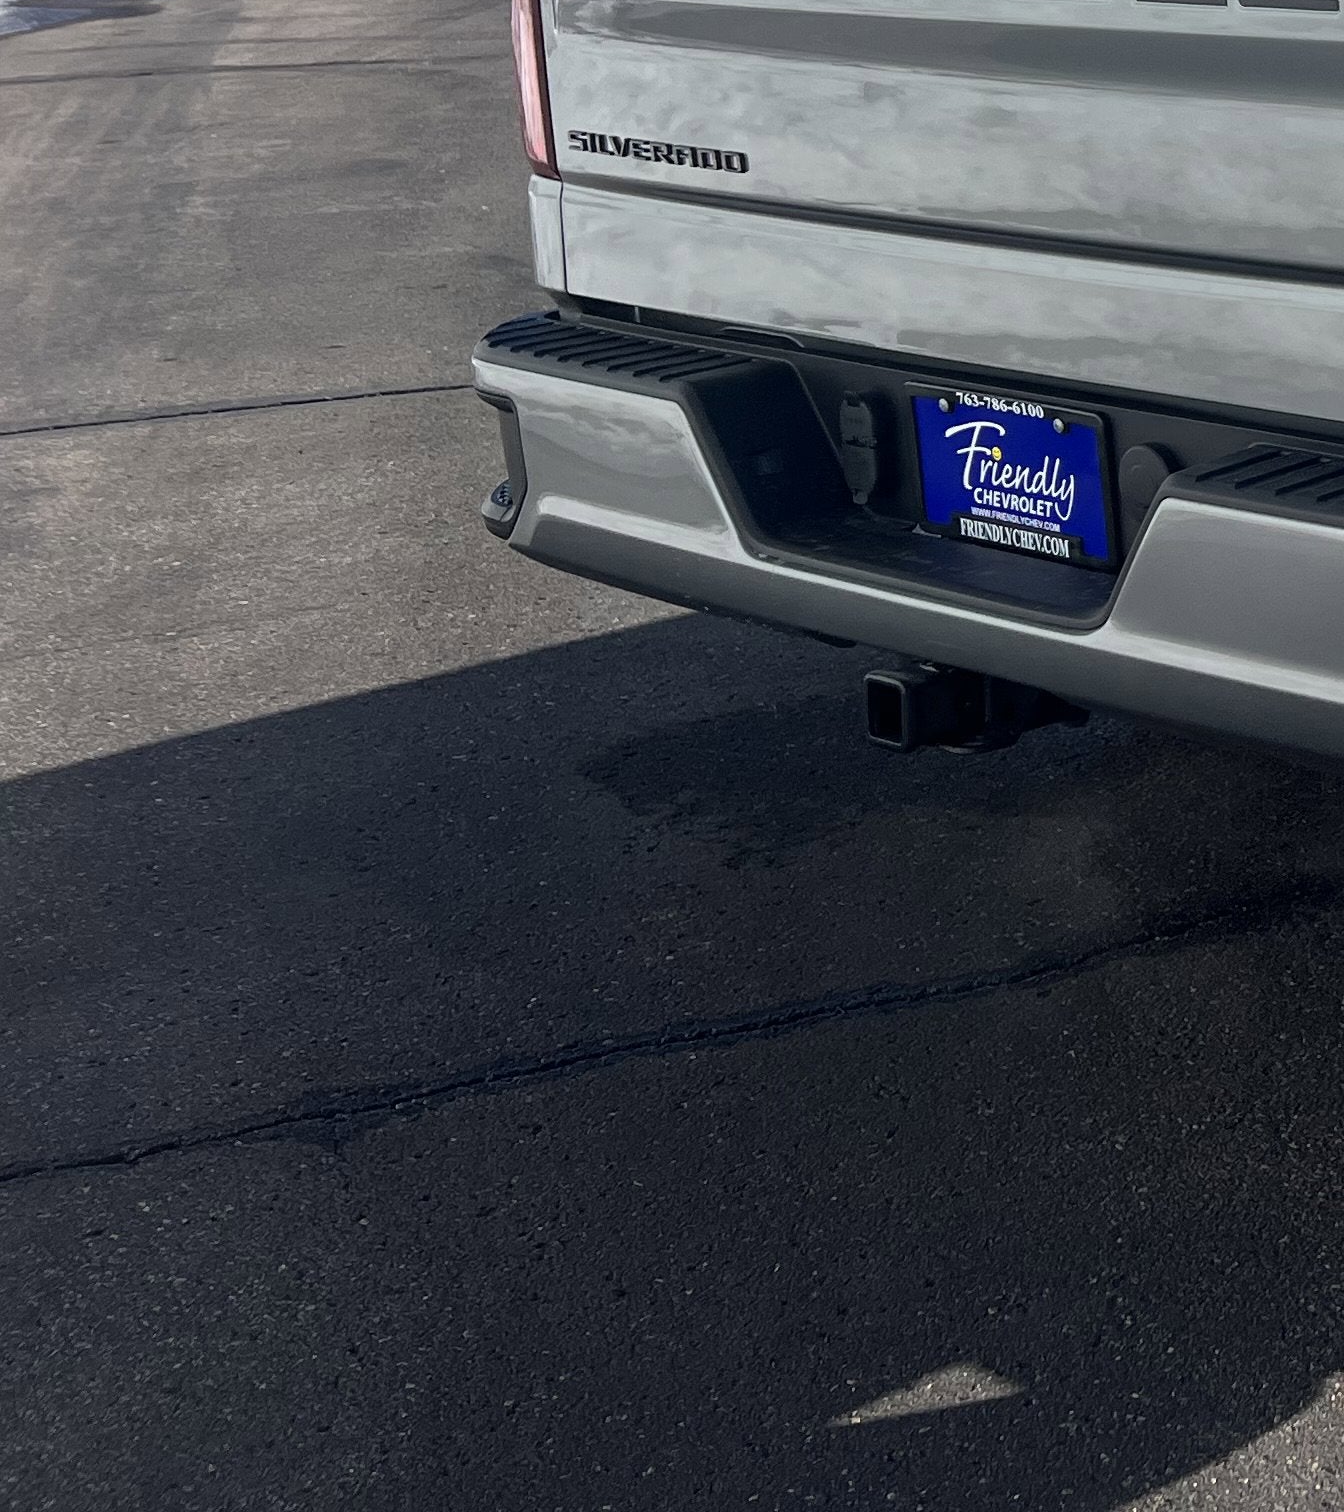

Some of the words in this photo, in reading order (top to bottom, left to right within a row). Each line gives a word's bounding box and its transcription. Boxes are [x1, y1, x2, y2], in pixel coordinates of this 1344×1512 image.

[567, 130, 749, 174] SILVERADO
[955, 392, 1044, 419] 763-786-6100
[944, 420, 1075, 521] Friendly
[973, 488, 1054, 518] CHEVROLET
[959, 517, 1070, 558] FRIENDLYCHEV.COM
